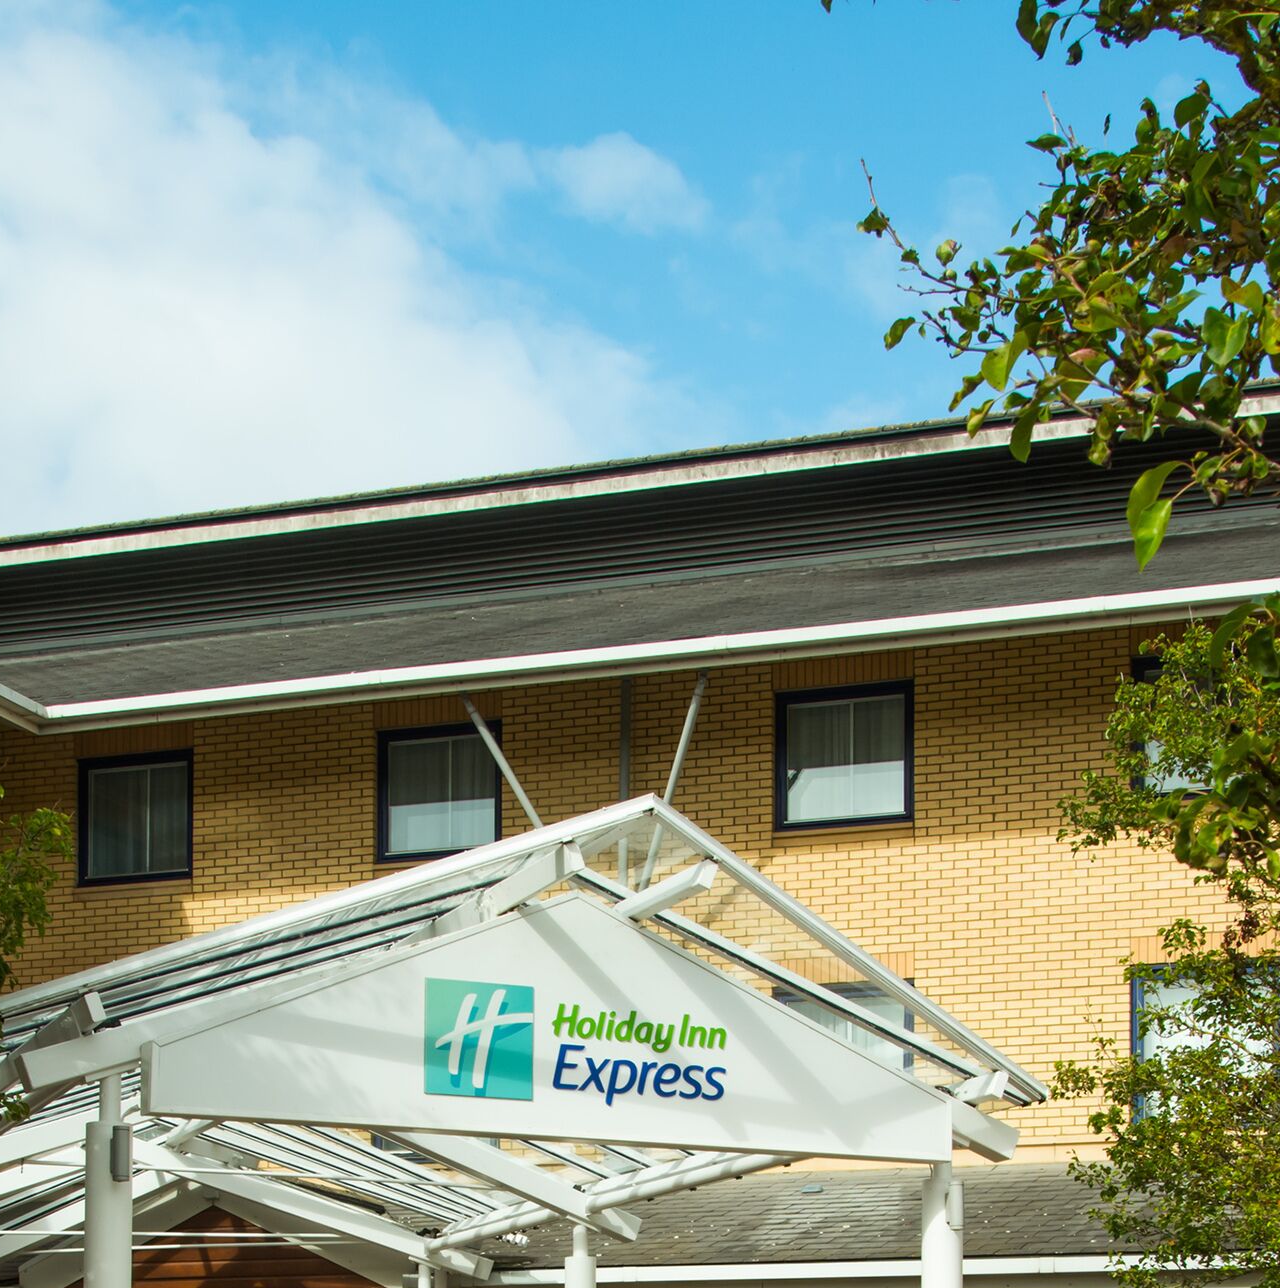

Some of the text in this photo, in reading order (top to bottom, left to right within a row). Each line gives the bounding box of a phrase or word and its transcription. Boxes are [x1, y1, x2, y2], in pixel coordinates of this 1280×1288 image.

[552, 1003, 727, 1053] Holiday Inn
[552, 1043, 726, 1106] Express
